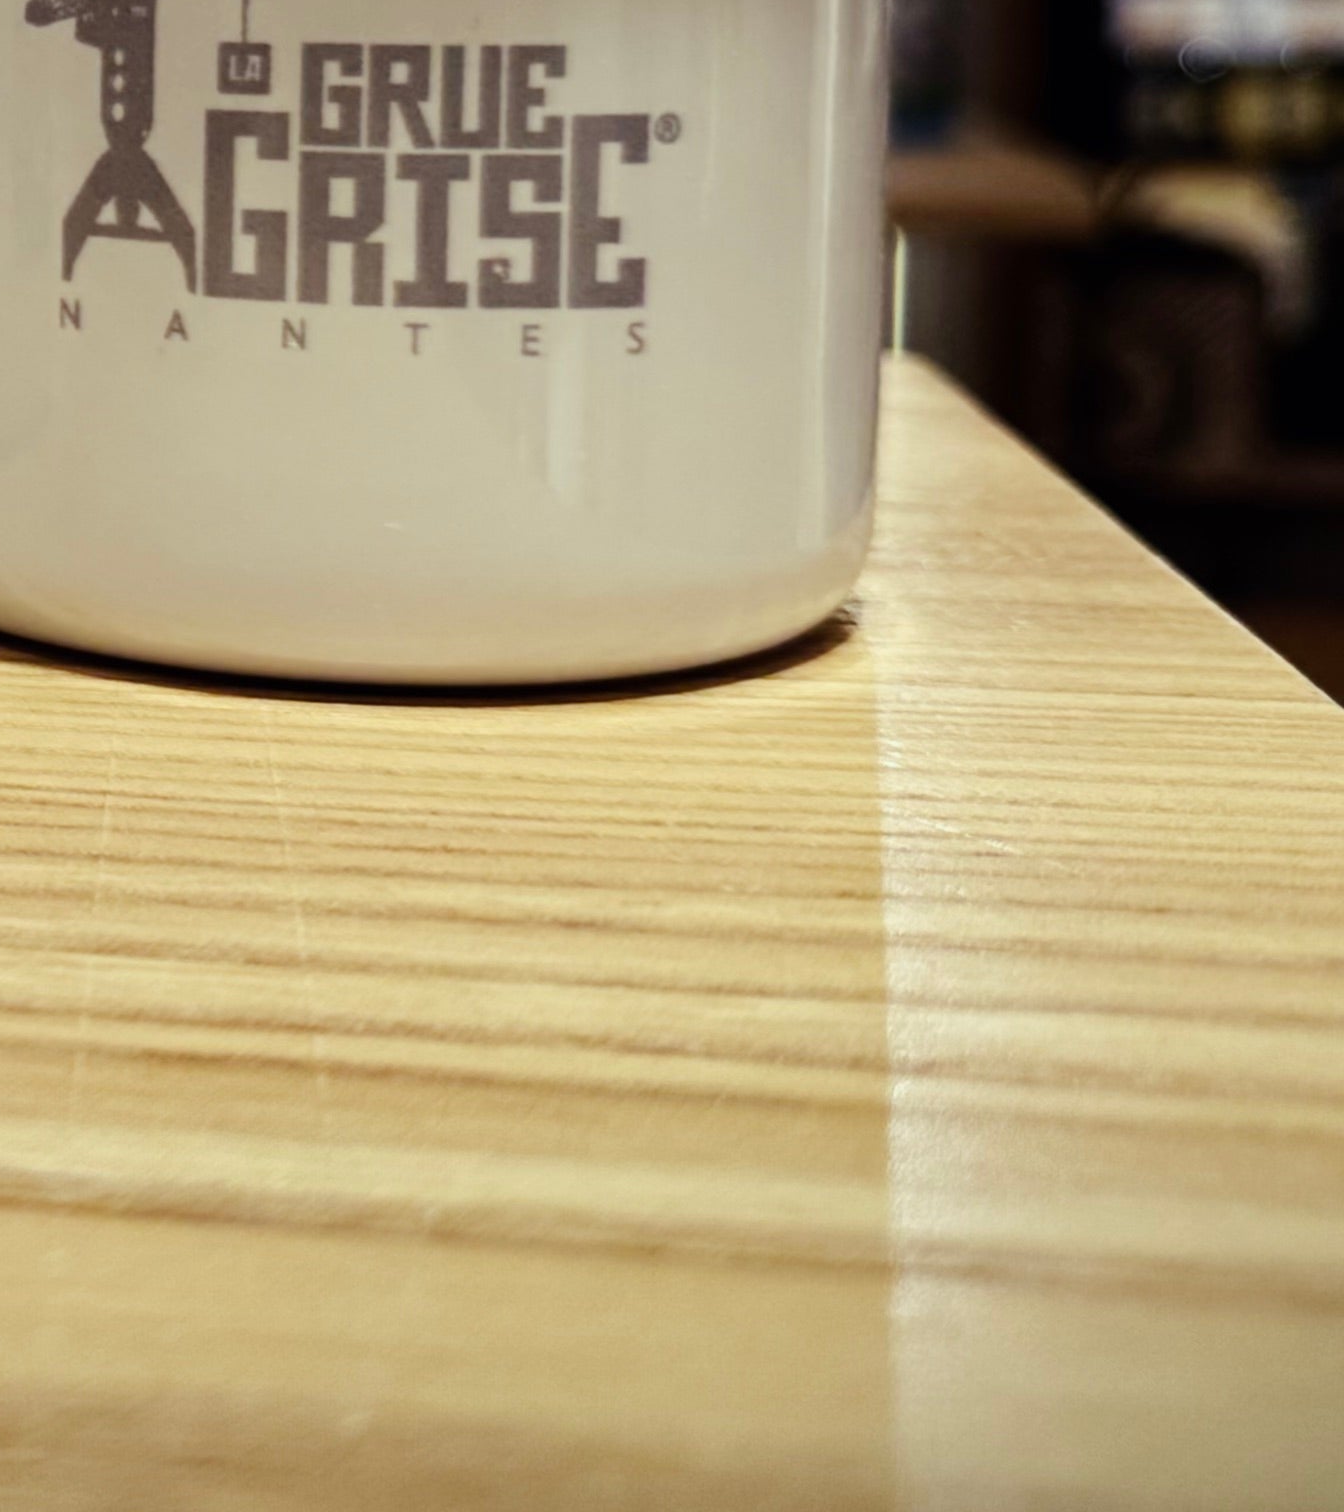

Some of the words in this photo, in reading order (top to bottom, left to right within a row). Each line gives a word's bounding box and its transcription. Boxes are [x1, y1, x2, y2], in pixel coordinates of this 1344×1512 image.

[229, 54, 262, 81] LA
[299, 42, 568, 149] GRUE
[58, 298, 648, 357] NANTES
